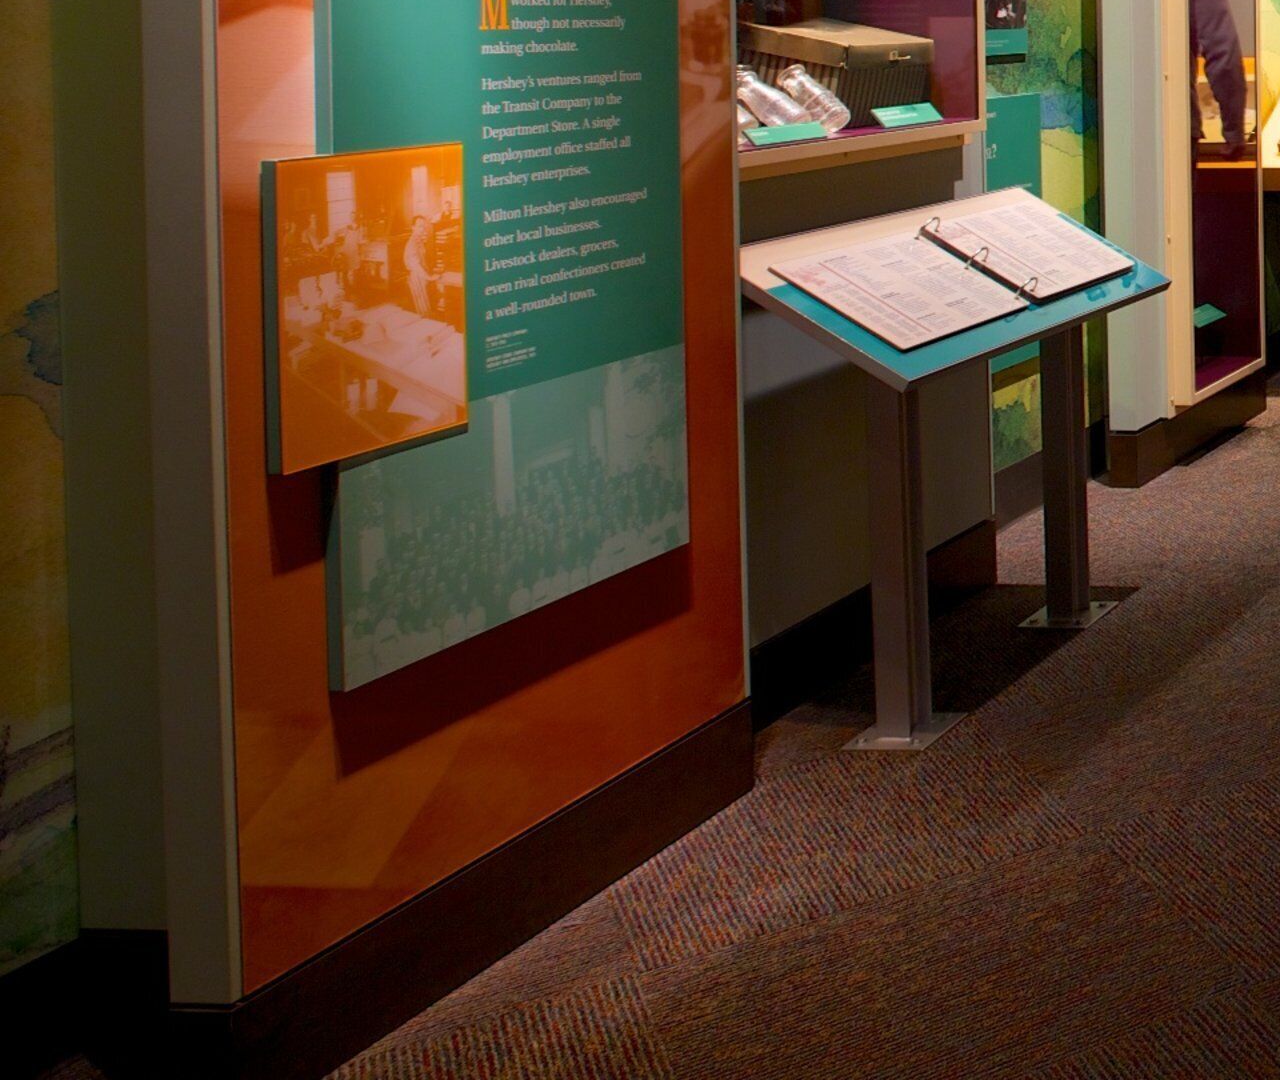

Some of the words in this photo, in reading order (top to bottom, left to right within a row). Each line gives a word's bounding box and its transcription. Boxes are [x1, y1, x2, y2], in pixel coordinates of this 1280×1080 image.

[511, 17, 550, 32] though
[552, 18, 570, 29] not
[572, 16, 626, 31] necessarily
[481, 41, 524, 57] making
[525, 40, 579, 53] chocolate.
[481, 75, 535, 92] Hershey's
[537, 74, 582, 87] ventures
[583, 71, 617, 87] ranged
[619, 70, 642, 83] from
[481, 102, 501, 115] the
[502, 99, 540, 113] Transit
[542, 96, 592, 112] Company
[594, 95, 605, 106] to
[606, 93, 622, 105] the
[482, 123, 550, 141] Department
[551, 120, 580, 133] Store.
[582, 118, 590, 129] A
[591, 116, 621, 131] single
[482, 145, 552, 165] employment
[554, 142, 583, 156] office
[584, 137, 617, 152] staffed
[619, 136, 631, 148] all
[482, 171, 529, 188] Hershey
[531, 165, 591, 183] enterprises.
[483, 205, 521, 223] Milton
[523, 200, 566, 218] Hershey
[568, 198, 590, 210] also
[591, 188, 647, 207] encouraged
[483, 232, 515, 248] other
[516, 226, 542, 242] local
[544, 219, 602, 238] businesses.
[484, 251, 536, 272] Livestock
[538, 246, 579, 263] dealers,
[484, 281, 513, 296] even
[514, 275, 539, 292] rival
[540, 261, 610, 286] confectioners
[610, 253, 646, 272] created
[485, 310, 493, 321] a
[494, 291, 568, 318] well-rounded
[569, 287, 597, 303] town.
